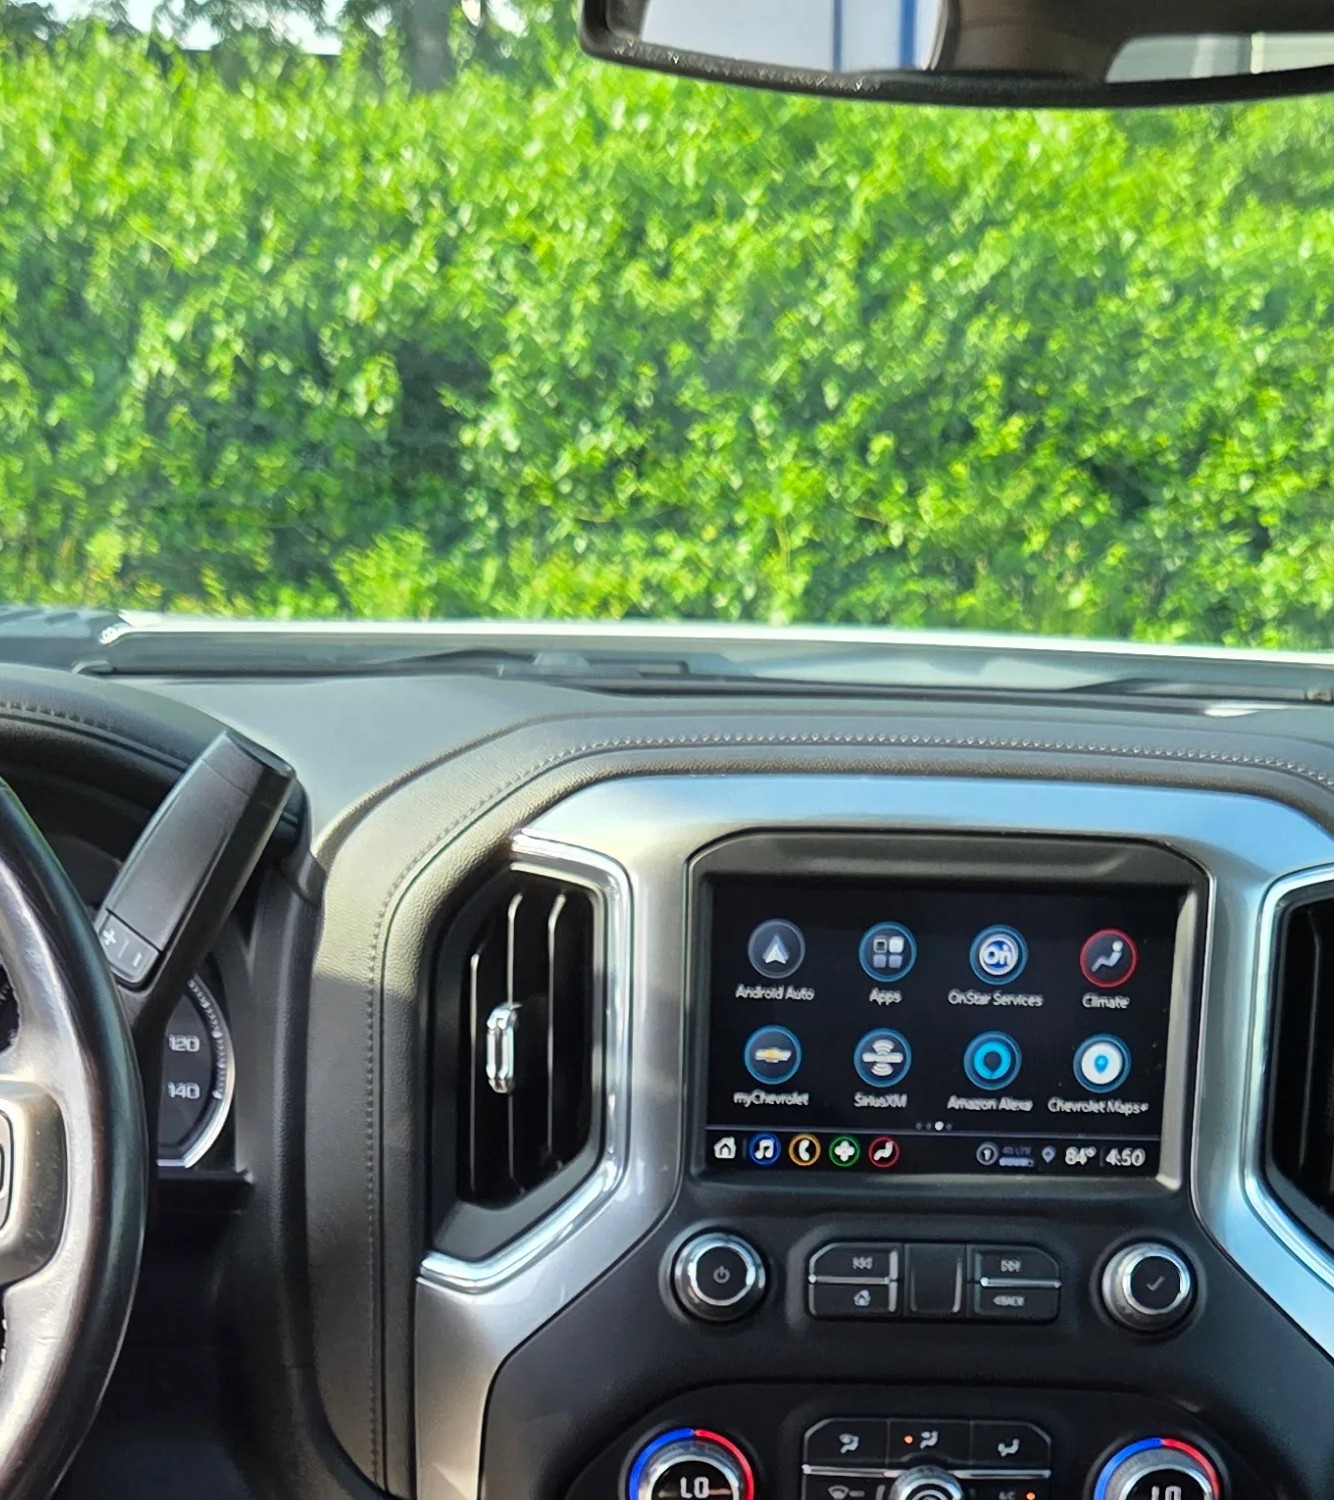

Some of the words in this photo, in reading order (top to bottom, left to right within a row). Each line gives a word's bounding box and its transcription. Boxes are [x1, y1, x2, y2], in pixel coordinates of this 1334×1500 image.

[735, 984, 784, 1000] Android
[785, 985, 815, 1001] Auto
[869, 988, 902, 1006] Apps
[947, 988, 991, 1006] OnStar
[993, 990, 1044, 1007] Services
[1082, 992, 1130, 1009] Climate
[168, 1035, 200, 1053] 120
[168, 1082, 200, 1099] 140
[733, 1088, 809, 1107] myChevrolet
[854, 1092, 908, 1108] SiriusXM
[947, 1095, 997, 1111] Amazon
[998, 1097, 1033, 1112] Alexa
[1047, 1097, 1105, 1113] Chevrolet
[1106, 1099, 1149, 1117] Maps+
[1105, 1147, 1146, 1167] 4:50
